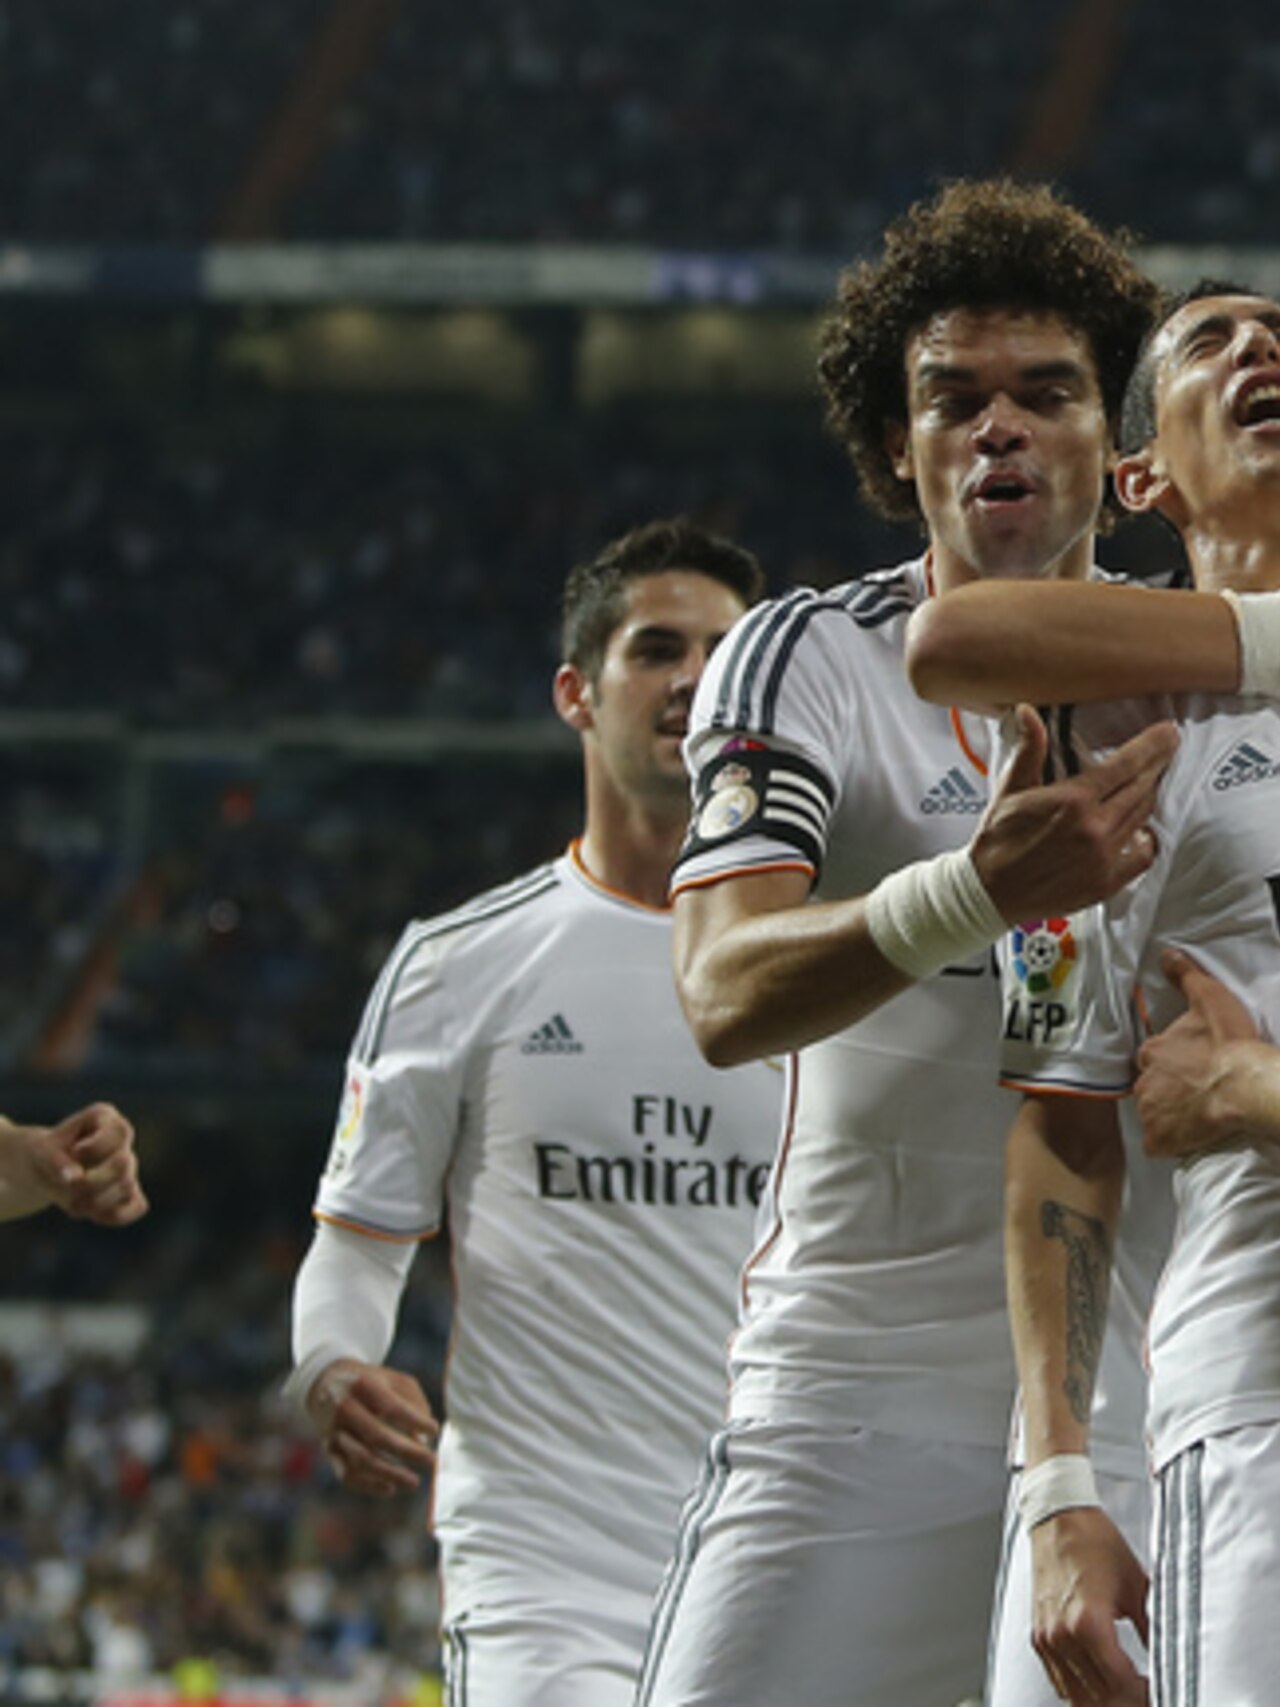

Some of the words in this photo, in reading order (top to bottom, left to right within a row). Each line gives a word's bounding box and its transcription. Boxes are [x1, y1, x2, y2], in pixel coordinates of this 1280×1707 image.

[1004, 1000, 1068, 1043] LFP
[632, 1095, 713, 1147] Fly
[533, 1142, 774, 1208] Emirate
